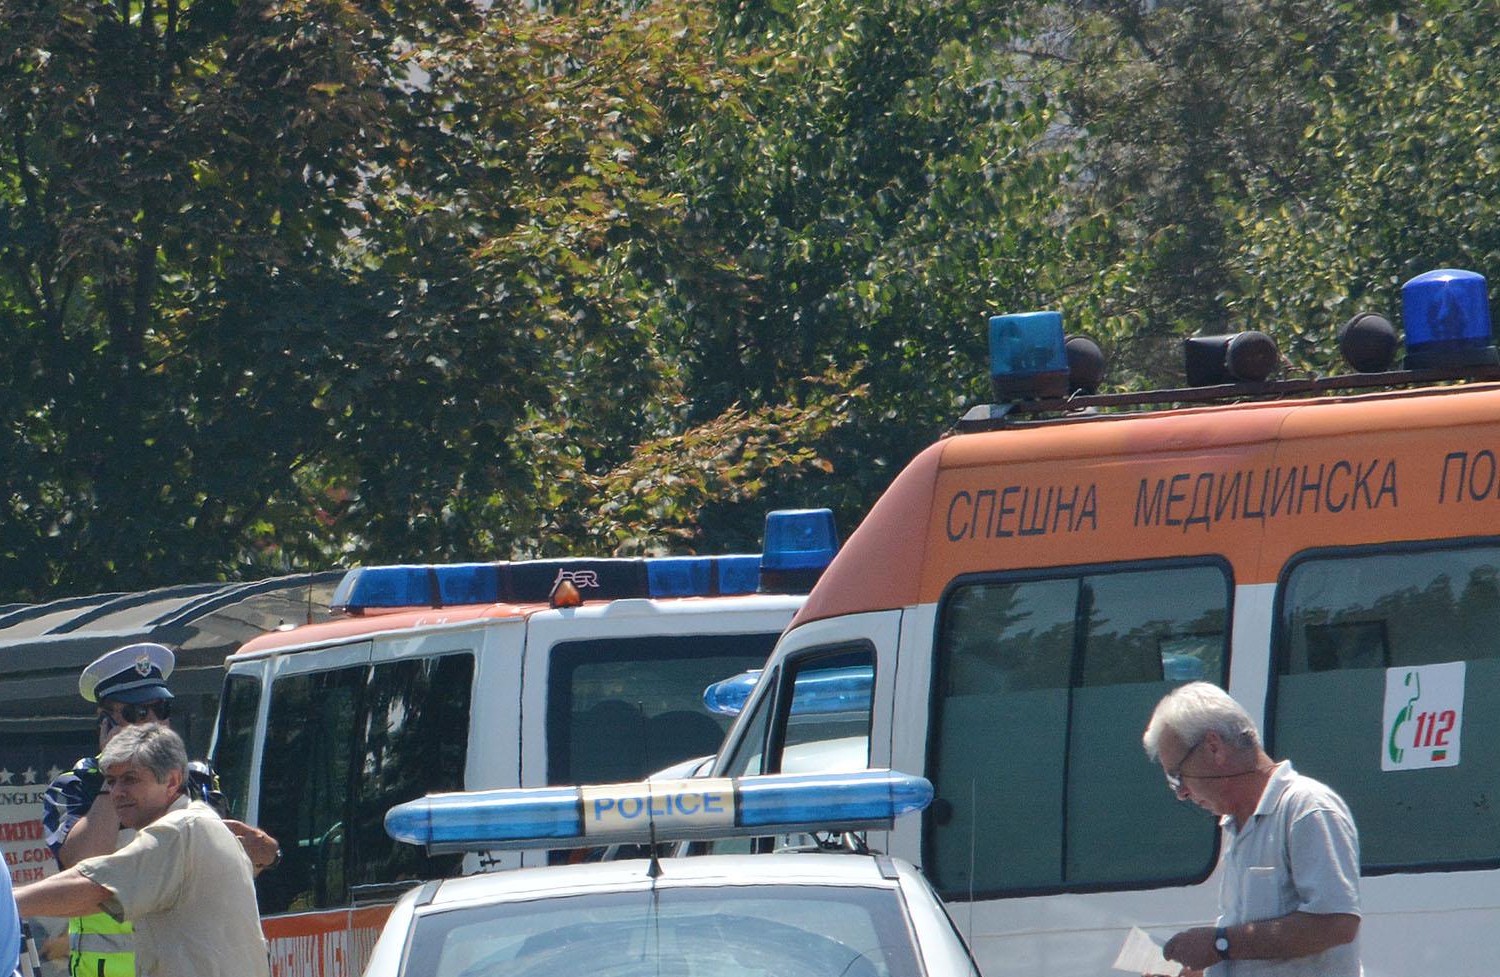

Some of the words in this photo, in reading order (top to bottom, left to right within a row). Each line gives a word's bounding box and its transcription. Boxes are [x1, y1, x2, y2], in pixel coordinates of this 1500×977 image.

[946, 484, 1097, 542] СПЕШНА
[1134, 458, 1397, 534] МЕДИЦИНСКА
[1438, 449, 1500, 505] ПО
[1413, 709, 1457, 748] 112
[594, 792, 724, 821] POLICE
